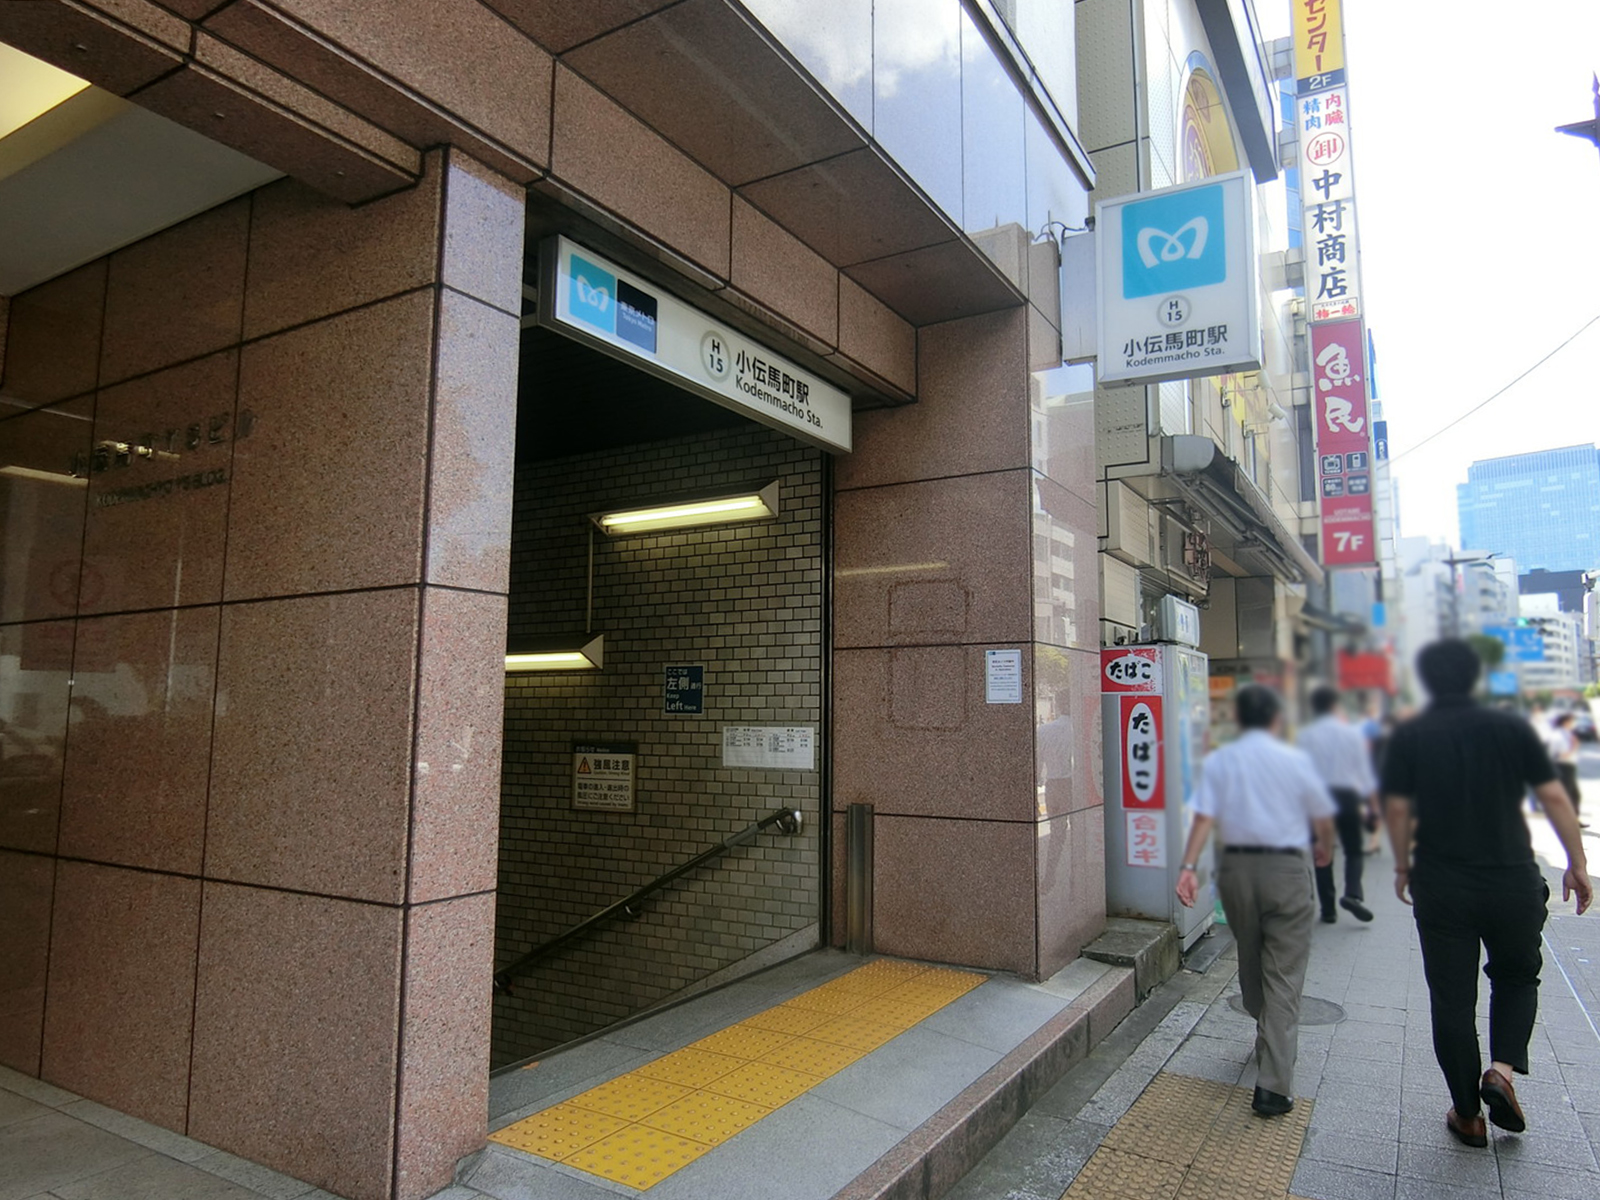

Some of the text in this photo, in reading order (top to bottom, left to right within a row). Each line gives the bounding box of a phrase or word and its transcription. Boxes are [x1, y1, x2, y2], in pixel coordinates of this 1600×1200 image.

[1309, 75, 1332, 90] 2F
[1303, 99, 1322, 130] 精肉
[1324, 93, 1345, 126] 内臓
[1312, 168, 1349, 300] 中村商店
[1167, 310, 1183, 322] 15
[1169, 300, 1179, 310] H
[711, 338, 721, 355] H
[1123, 324, 1228, 358] 小伝馬町駅
[709, 357, 724, 374] 15
[1126, 346, 1225, 369] Kodemmacho Sta.
[736, 349, 810, 406] 小伝馬町駅
[1315, 342, 1364, 434] 魚民
[735, 375, 824, 429] Kodemmacho Sta.
[1333, 531, 1364, 552] 7F
[1109, 660, 1153, 680] たばこ
[666, 701, 683, 711] Left
[1131, 712, 1151, 791] たばこ
[593, 758, 630, 771] 強風注意
[1132, 815, 1159, 863] 合カギ
